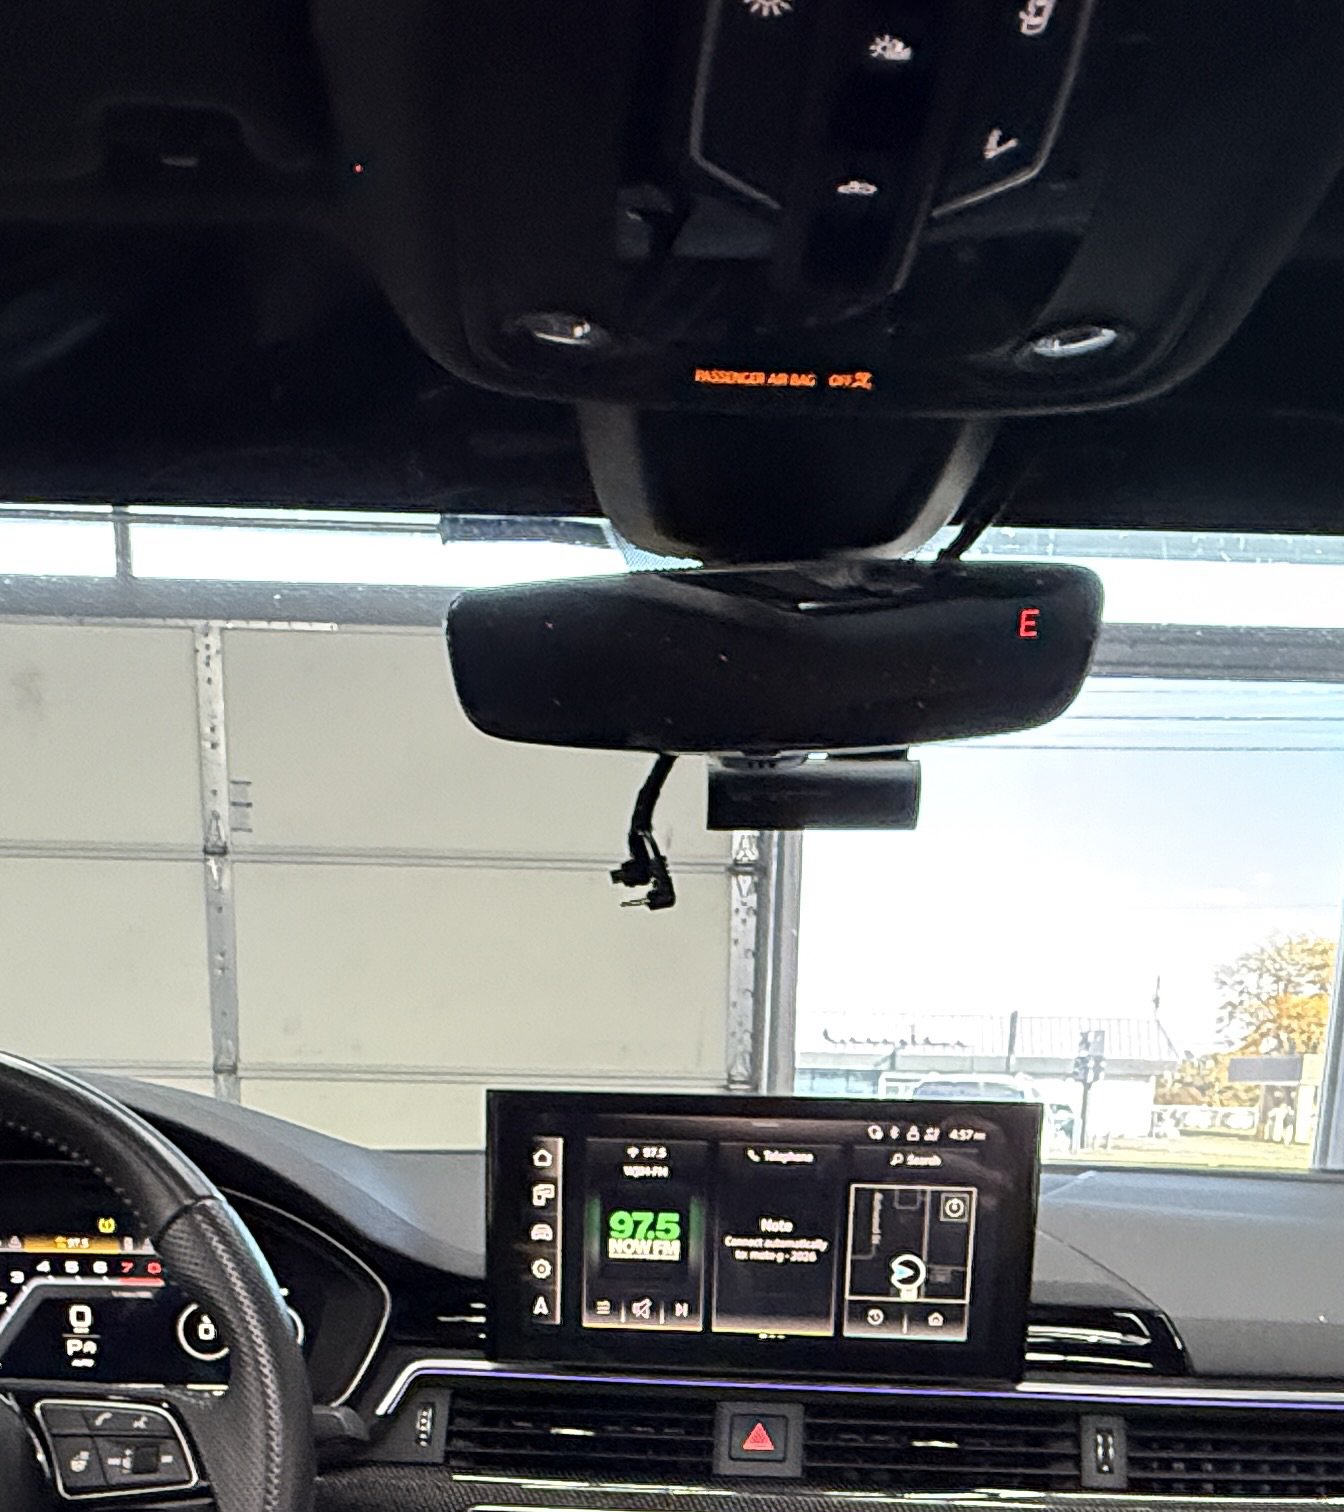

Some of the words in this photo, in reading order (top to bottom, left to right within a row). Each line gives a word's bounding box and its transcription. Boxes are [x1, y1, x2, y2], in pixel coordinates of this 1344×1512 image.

[695, 369, 766, 384] PASSENGER
[1020, 609, 1040, 637] E
[763, 1150, 814, 1164] Telephone
[609, 1210, 681, 1240] 97.5
[760, 1217, 793, 1233] Note
[609, 1239, 652, 1255] NOW
[36, 1260, 51, 1273] 4
[121, 1261, 134, 1273] 7
[10, 1270, 25, 1284] 3
